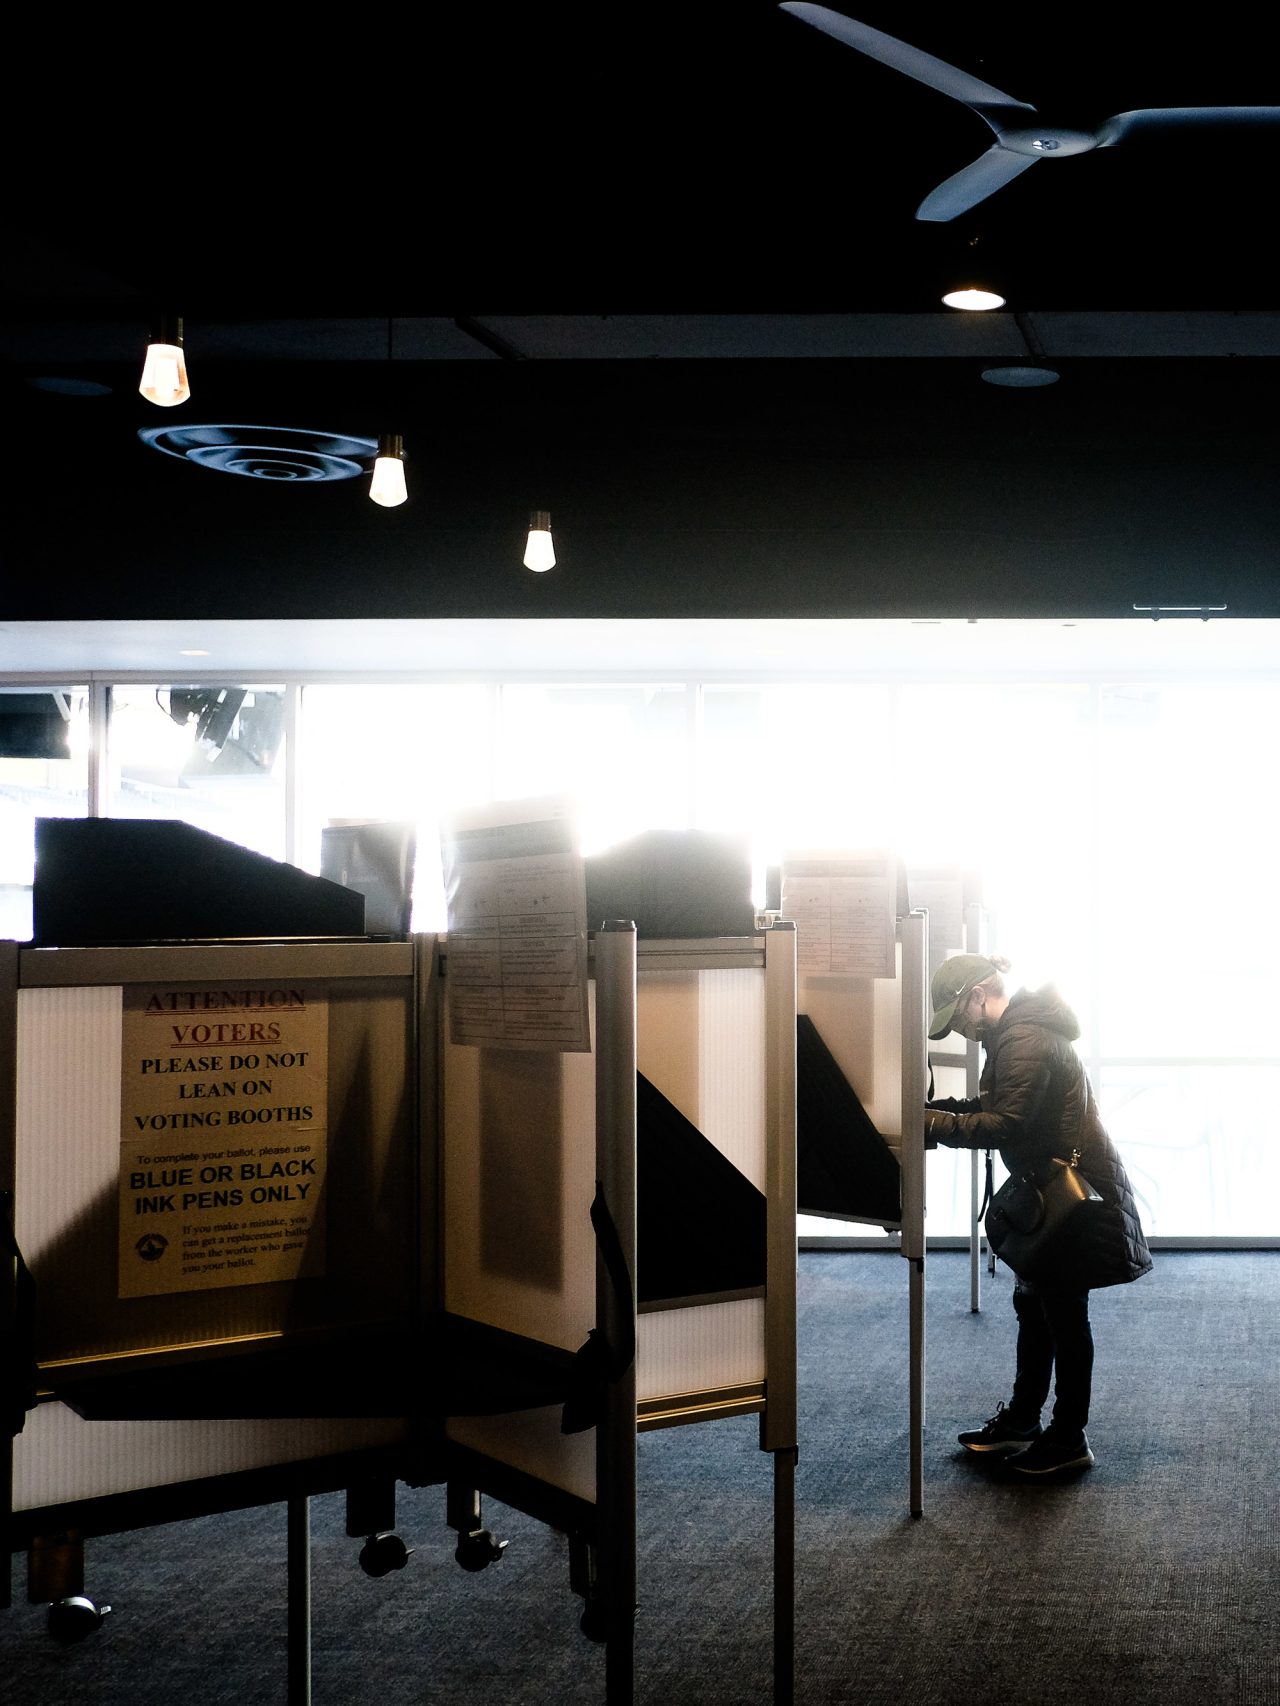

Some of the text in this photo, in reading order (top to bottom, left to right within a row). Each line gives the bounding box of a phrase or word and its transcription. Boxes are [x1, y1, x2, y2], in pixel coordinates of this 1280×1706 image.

[146, 989, 306, 1011] ATTENTION
[171, 1021, 281, 1044] VOTERS
[141, 1052, 309, 1074] PLEASE DO NOT
[178, 1079, 273, 1100] LEAN ON
[134, 1105, 313, 1131] VOTING BOOTHS
[136, 1155, 151, 1165] To
[153, 1151, 200, 1165] complete
[201, 1149, 224, 1161] your
[258, 1145, 291, 1157] please
[293, 1144, 311, 1153] use
[130, 1158, 316, 1190] BLUE OR BLACK
[135, 1183, 311, 1215] INK PENS ONLY
[182, 1224, 192, 1235] If
[193, 1224, 211, 1235] you
[213, 1221, 240, 1233] make
[289, 1216, 308, 1226] you
[182, 1239, 199, 1248] can
[201, 1236, 217, 1248] get
[226, 1230, 283, 1244] replacement
[182, 1250, 206, 1261] from
[207, 1248, 223, 1258] the
[225, 1245, 259, 1256] worker
[260, 1242, 280, 1252] who
[181, 1265, 201, 1276] you
[202, 1262, 225, 1275] your
